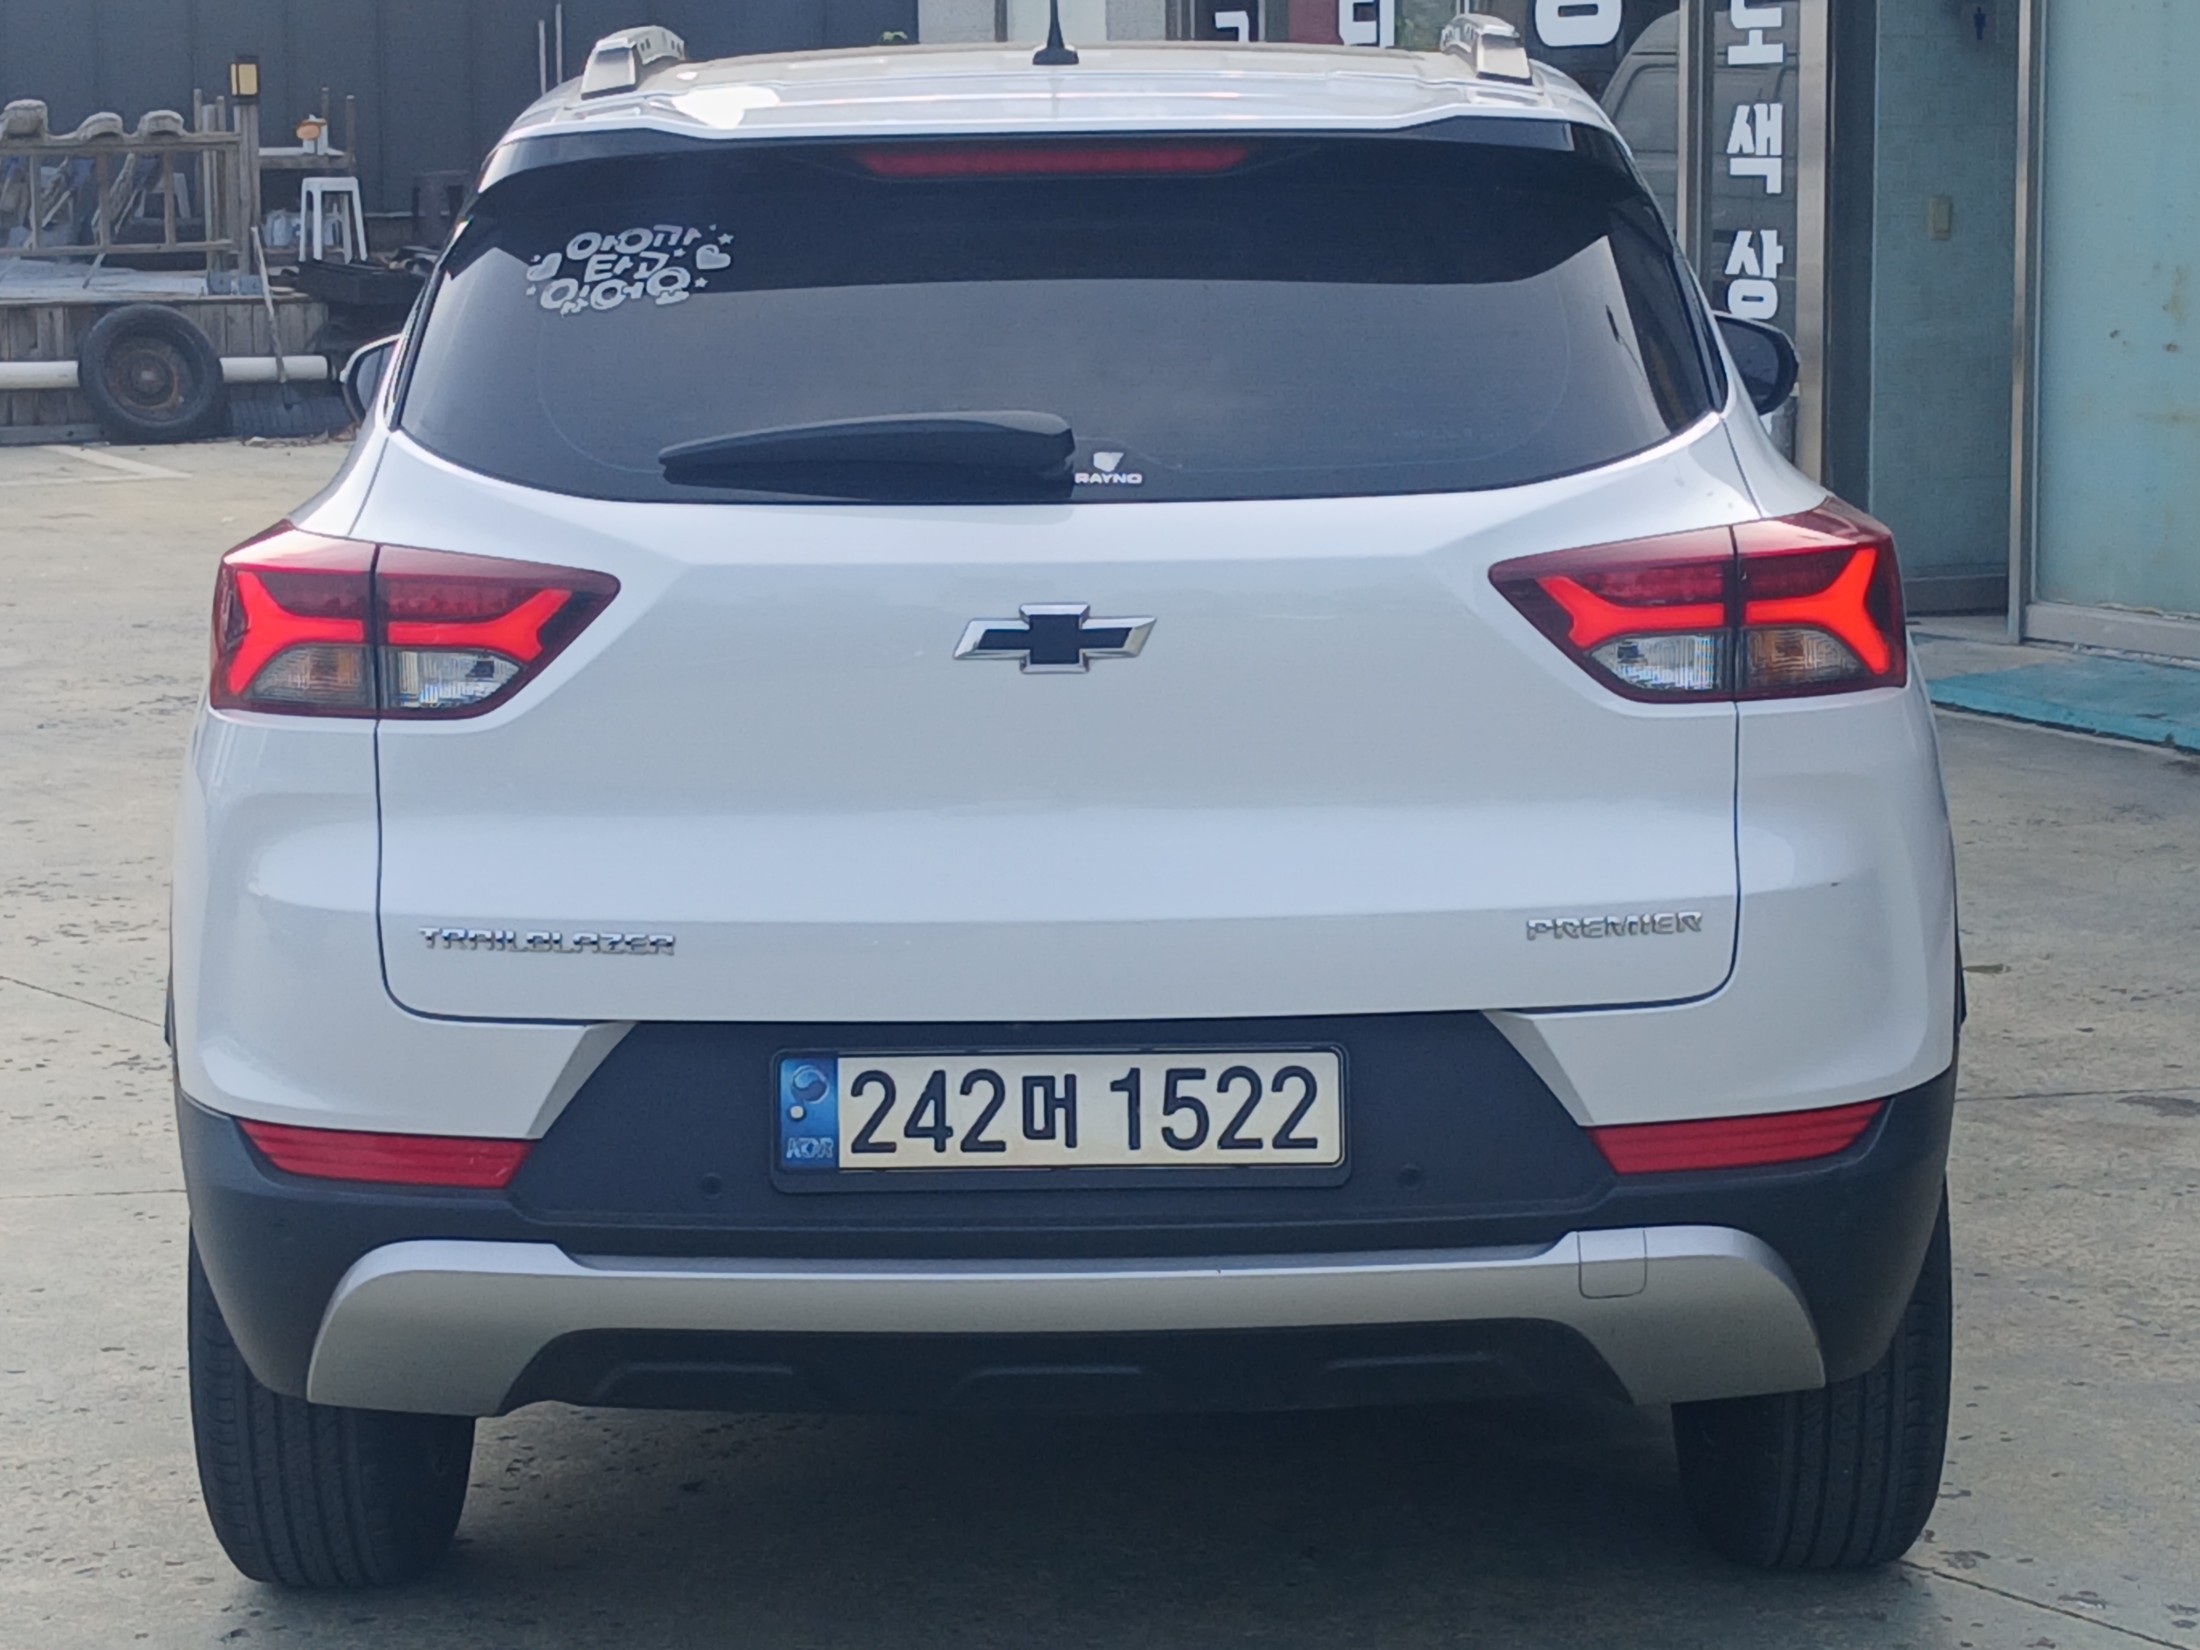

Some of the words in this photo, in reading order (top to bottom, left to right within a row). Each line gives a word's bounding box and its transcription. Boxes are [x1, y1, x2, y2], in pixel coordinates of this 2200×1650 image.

[584, 251, 670, 283] 타고
[540, 266, 691, 316] 있어요
[1074, 472, 1143, 484] RAYNO
[418, 926, 676, 956] TRAILBLAZER
[1526, 911, 1702, 941] PREMIER
[850, 1069, 1077, 1153] 242머
[1110, 1065, 1319, 1151] 1522
